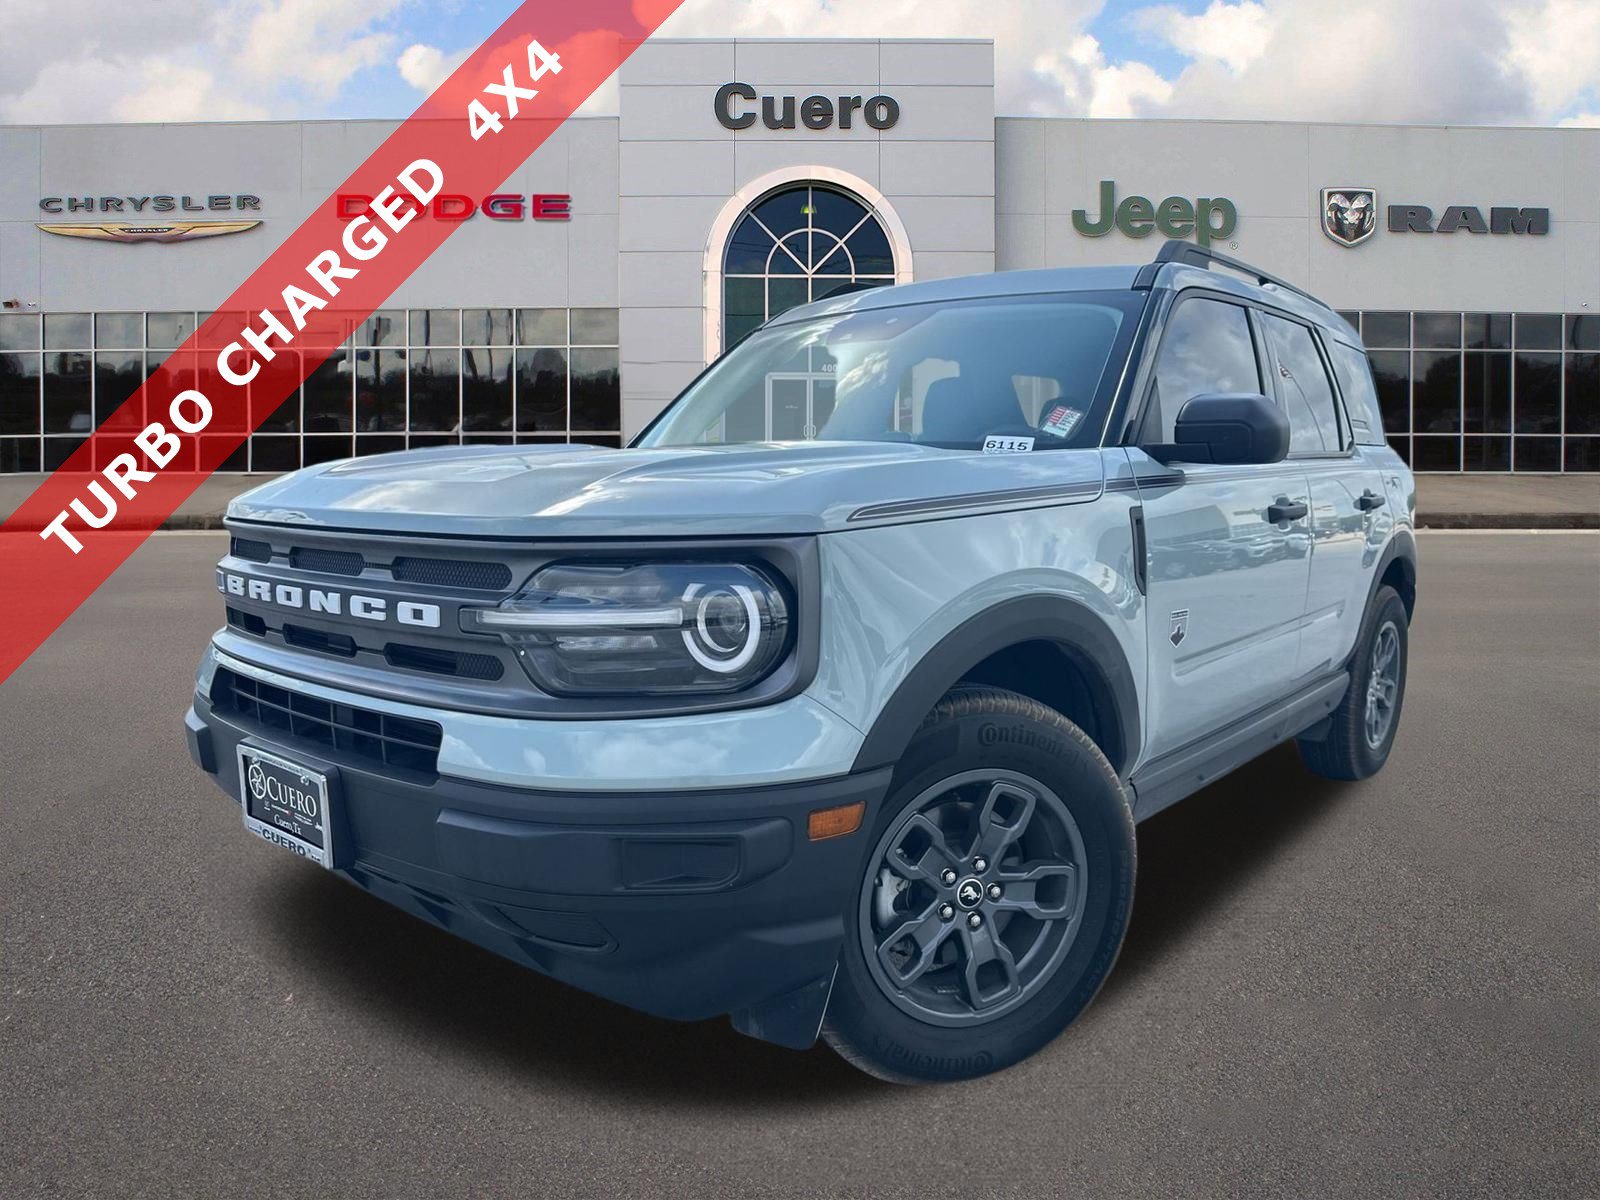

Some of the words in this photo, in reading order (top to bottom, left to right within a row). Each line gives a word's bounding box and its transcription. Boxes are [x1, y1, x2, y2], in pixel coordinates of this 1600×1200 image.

[714, 82, 900, 130] Cuero
[39, 194, 261, 213] CHRYSLER
[1071, 180, 1237, 250] Jeep
[1387, 204, 1550, 235] RAM
[985, 440, 1029, 451] 6115
[227, 574, 440, 628] BRONCO
[977, 722, 1080, 767] Continental
[267, 776, 317, 817] CUERO
[262, 829, 306, 857] CUERO
